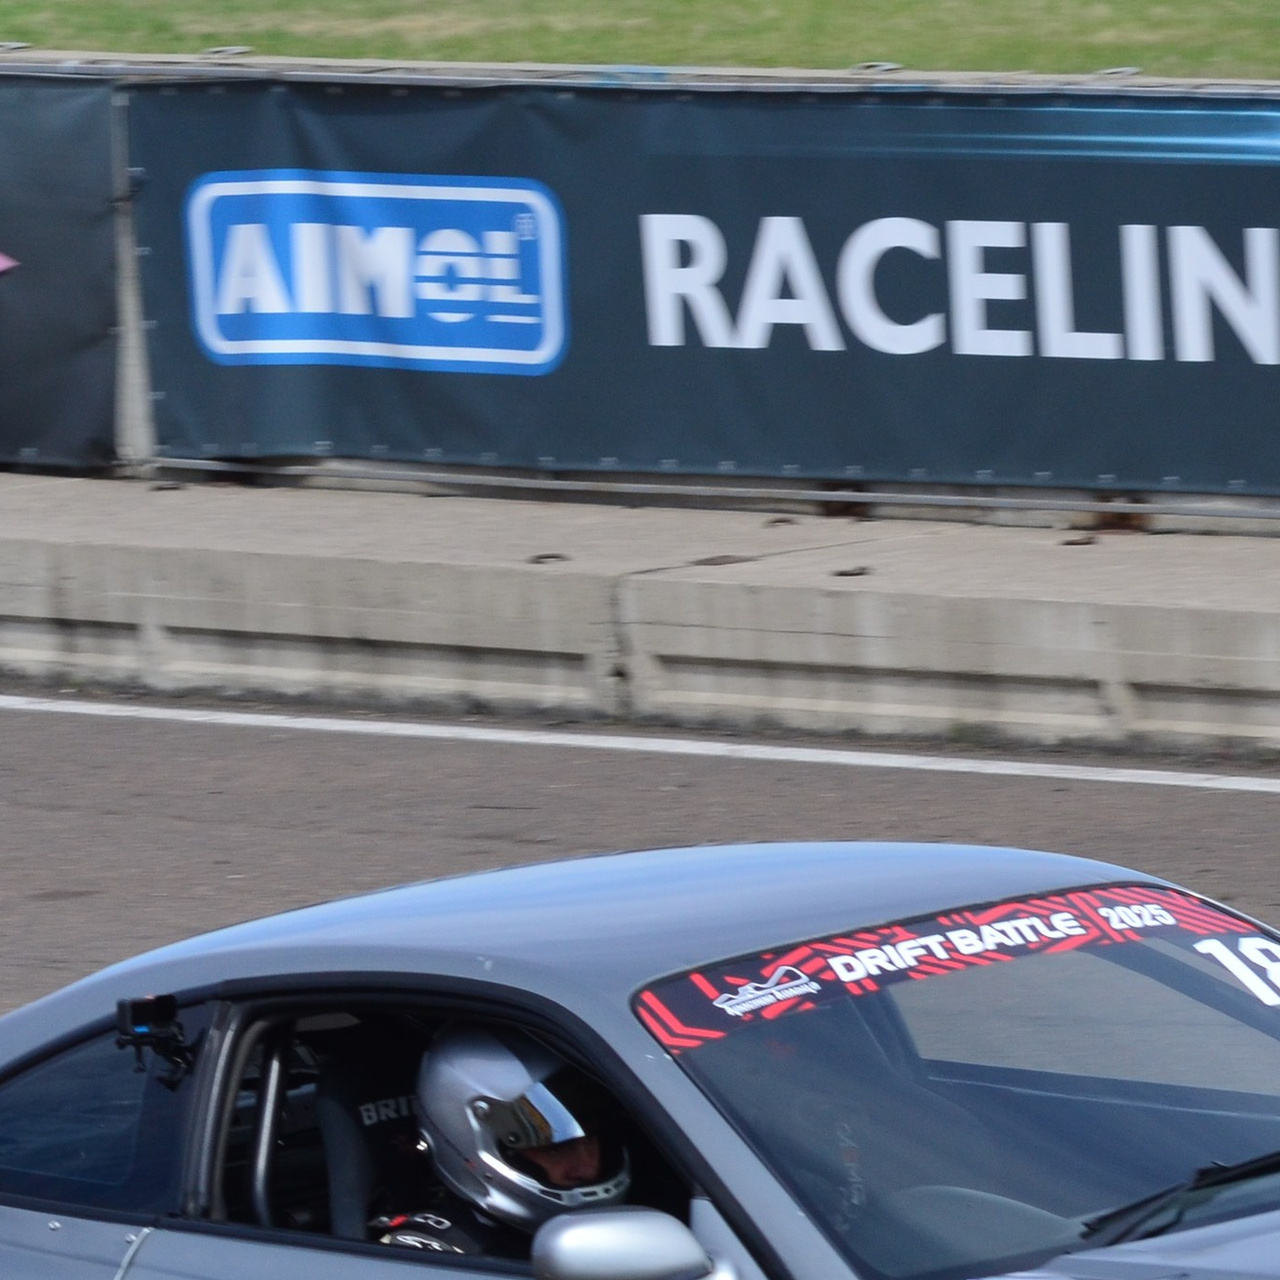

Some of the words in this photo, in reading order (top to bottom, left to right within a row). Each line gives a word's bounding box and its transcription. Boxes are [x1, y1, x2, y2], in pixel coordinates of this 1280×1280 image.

[215, 222, 542, 325] AIMOL
[826, 933, 950, 983] DRIFT
[946, 911, 1088, 956] BATTLE
[1097, 903, 1178, 931] 2025
[358, 1096, 421, 1127] BRI
